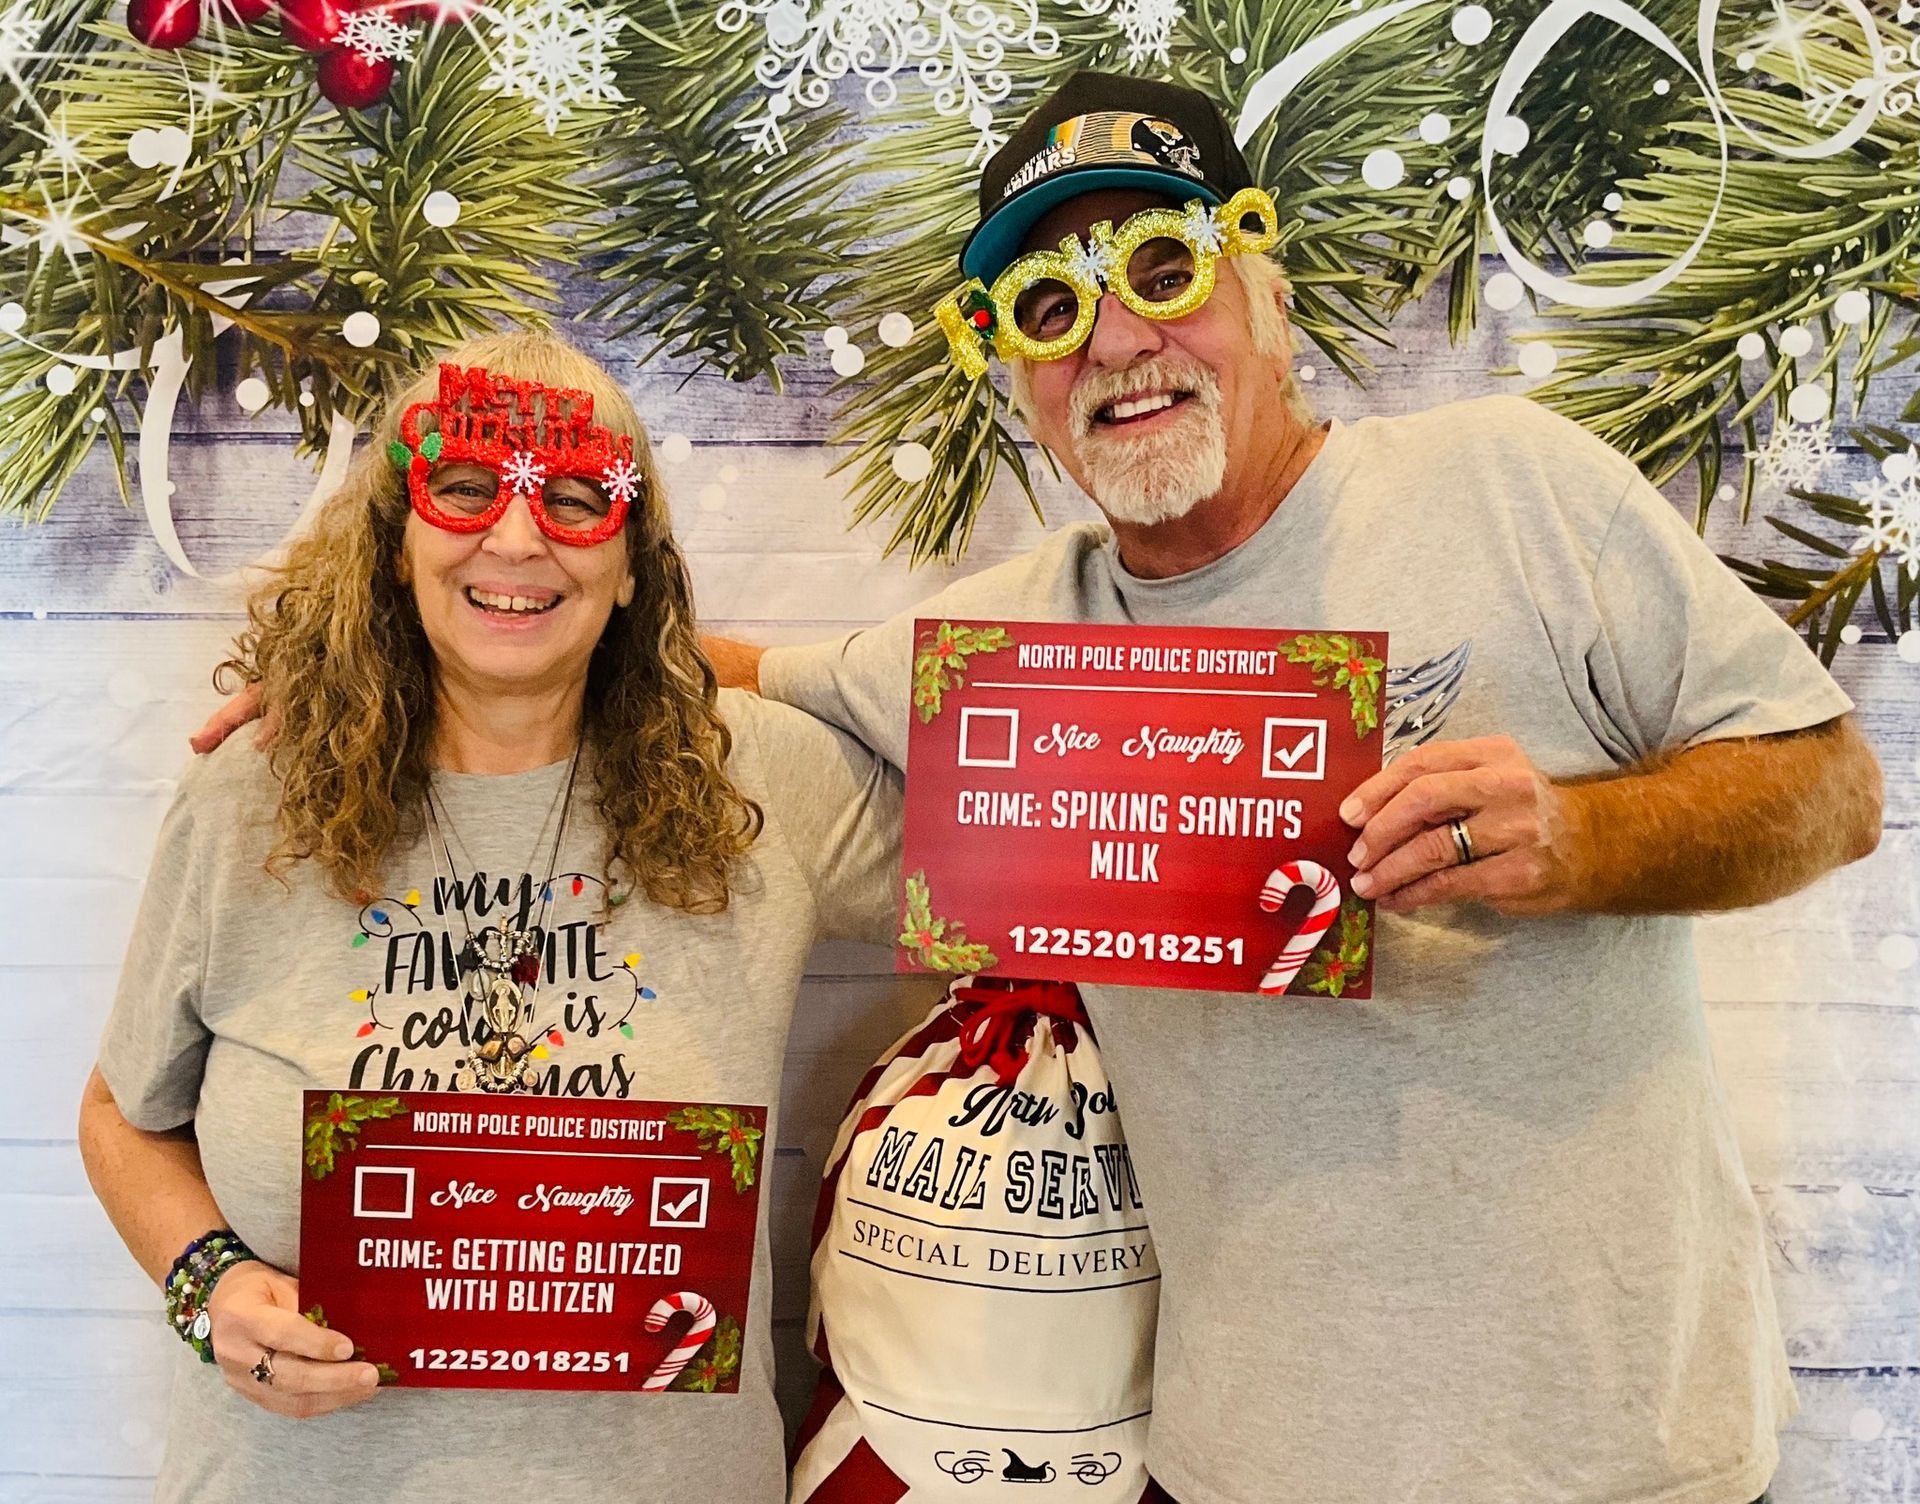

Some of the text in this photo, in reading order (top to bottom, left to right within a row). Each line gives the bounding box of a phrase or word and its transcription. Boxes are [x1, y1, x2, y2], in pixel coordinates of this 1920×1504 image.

[1018, 643, 1278, 676] NORTH POLE POLICE DISTRICT
[1033, 722, 1245, 765] Nice Naughty
[957, 789, 1303, 839] CRIME: SPIKING SANTA'S
[1090, 840, 1160, 883] MILK
[433, 872, 533, 931] my
[385, 920, 614, 994] FAVOITE
[1008, 925, 1244, 965] 12252018251
[402, 991, 606, 1050] colo is
[349, 1044, 635, 1099] Chrimas
[413, 1111, 667, 1142] NORTH POLE POLICE DISTRICT
[866, 1126, 992, 1211] MAIL
[430, 1180, 635, 1216] Nice Naughty
[358, 1237, 682, 1276] CRIME: GETTING BLITZED
[853, 1219, 1148, 1277] SPECIAL DELIVERY
[425, 1278, 615, 1314] WITH BLITZEN
[409, 1348, 629, 1373] 12252018251
